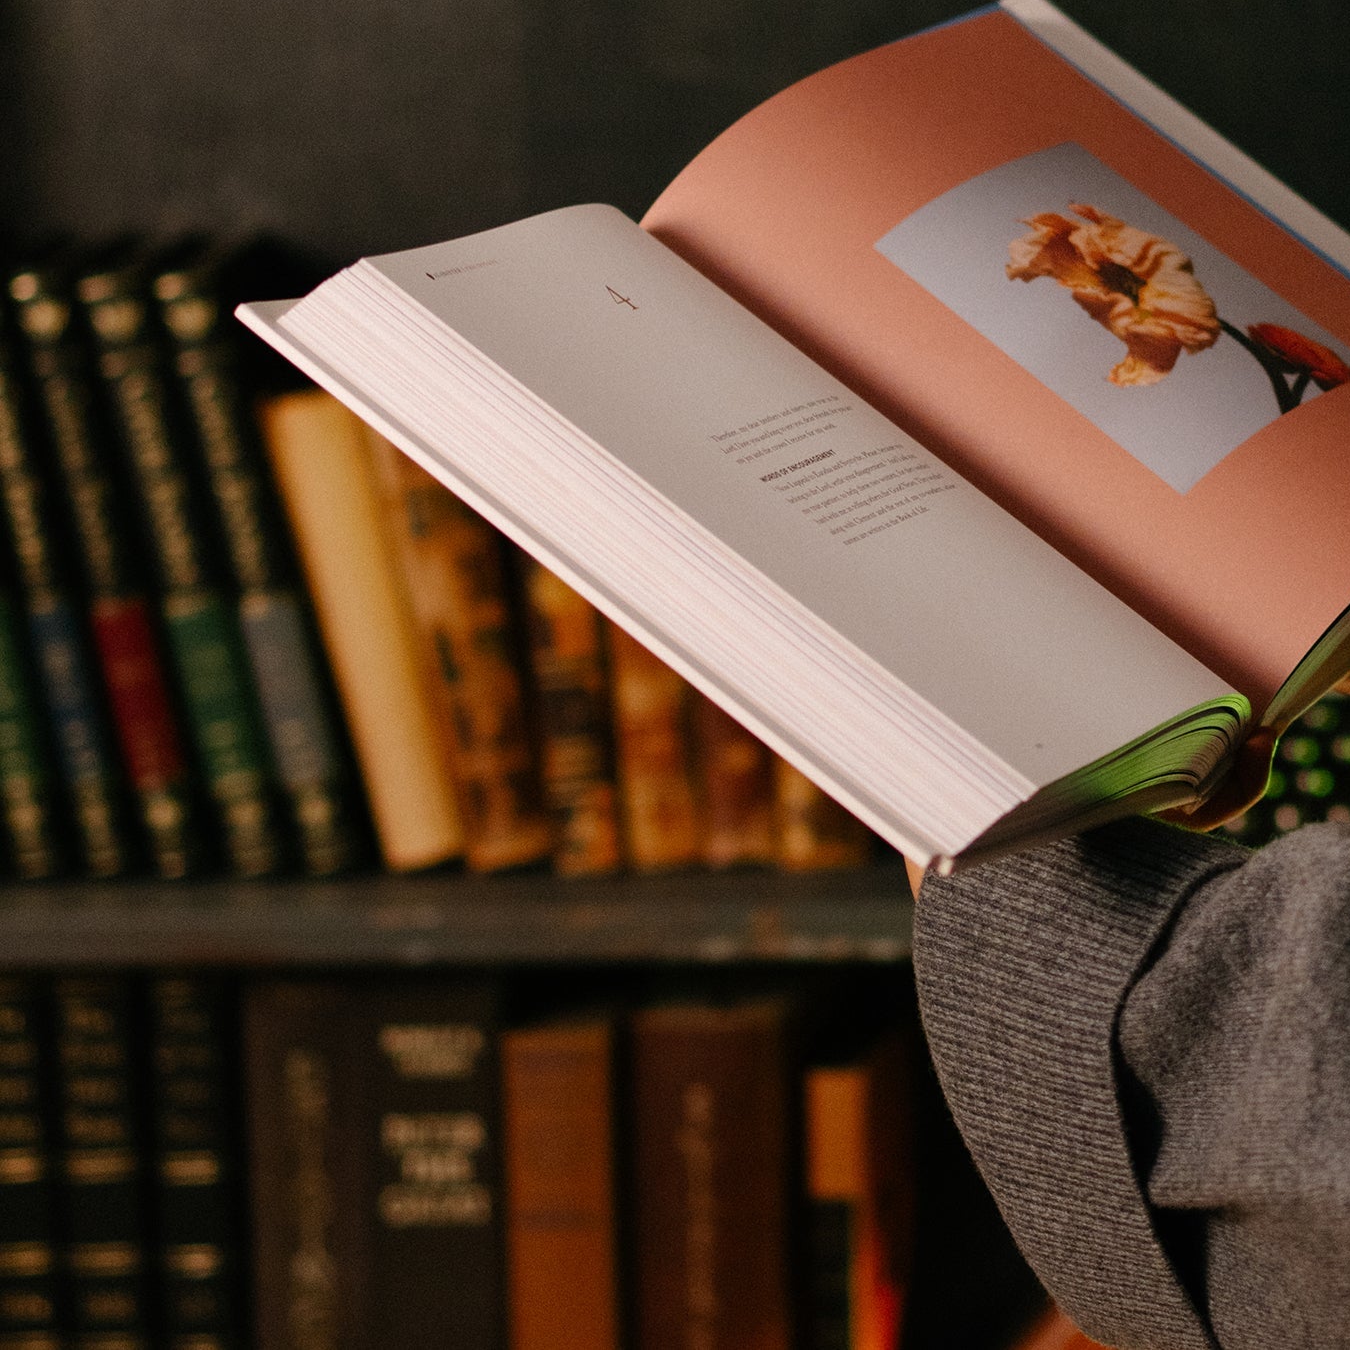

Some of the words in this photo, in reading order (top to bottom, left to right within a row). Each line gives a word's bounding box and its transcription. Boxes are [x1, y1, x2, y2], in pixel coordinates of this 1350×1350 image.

[605, 284, 639, 310] 4
[760, 471, 782, 482] WORDS
[787, 449, 835, 472] ENCOURAGEMENT
